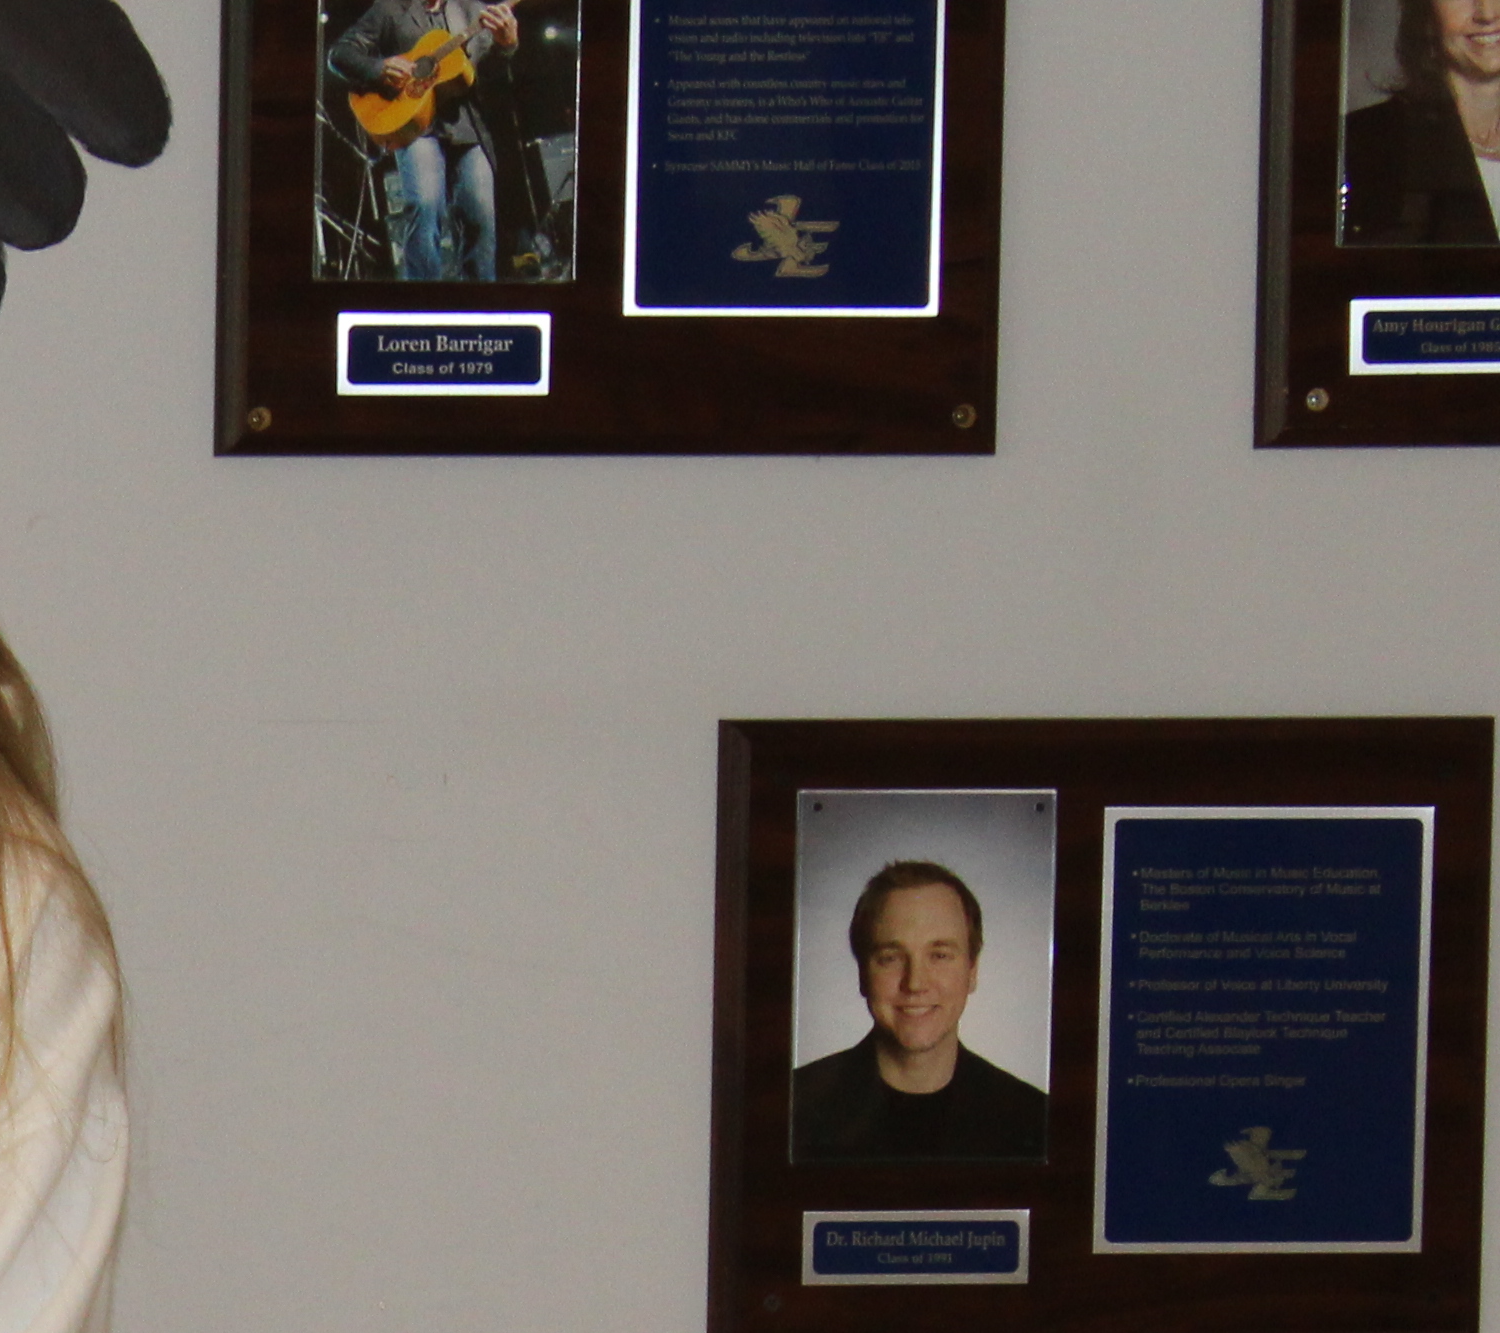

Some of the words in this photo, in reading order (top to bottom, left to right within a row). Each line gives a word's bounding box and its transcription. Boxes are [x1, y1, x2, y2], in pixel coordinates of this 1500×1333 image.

[1372, 319, 1408, 336] Amy
[1412, 318, 1485, 336] Hourigan
[377, 335, 431, 352] Loren
[436, 334, 514, 356] Barrigar
[1420, 342, 1452, 354] Class
[1454, 341, 1467, 354] of
[392, 362, 434, 375] Class
[438, 362, 454, 375] of
[459, 362, 493, 375] 1979
[1197, 867, 1209, 879] of
[1255, 867, 1267, 879] in
[1270, 867, 1308, 879] Music
[1142, 884, 1166, 895] The
[1309, 884, 1323, 895] of
[1326, 884, 1365, 895] Music
[1206, 931, 1220, 943] of
[1305, 931, 1317, 943] in
[1226, 948, 1251, 959] and
[1204, 979, 1217, 990] of
[1136, 1027, 1161, 1039] and
[826, 1231, 848, 1246] Dr.
[851, 1230, 905, 1246] Richard
[909, 1230, 963, 1246] Michael
[967, 1231, 1006, 1250] Jupin
[877, 1252, 908, 1264] Class
